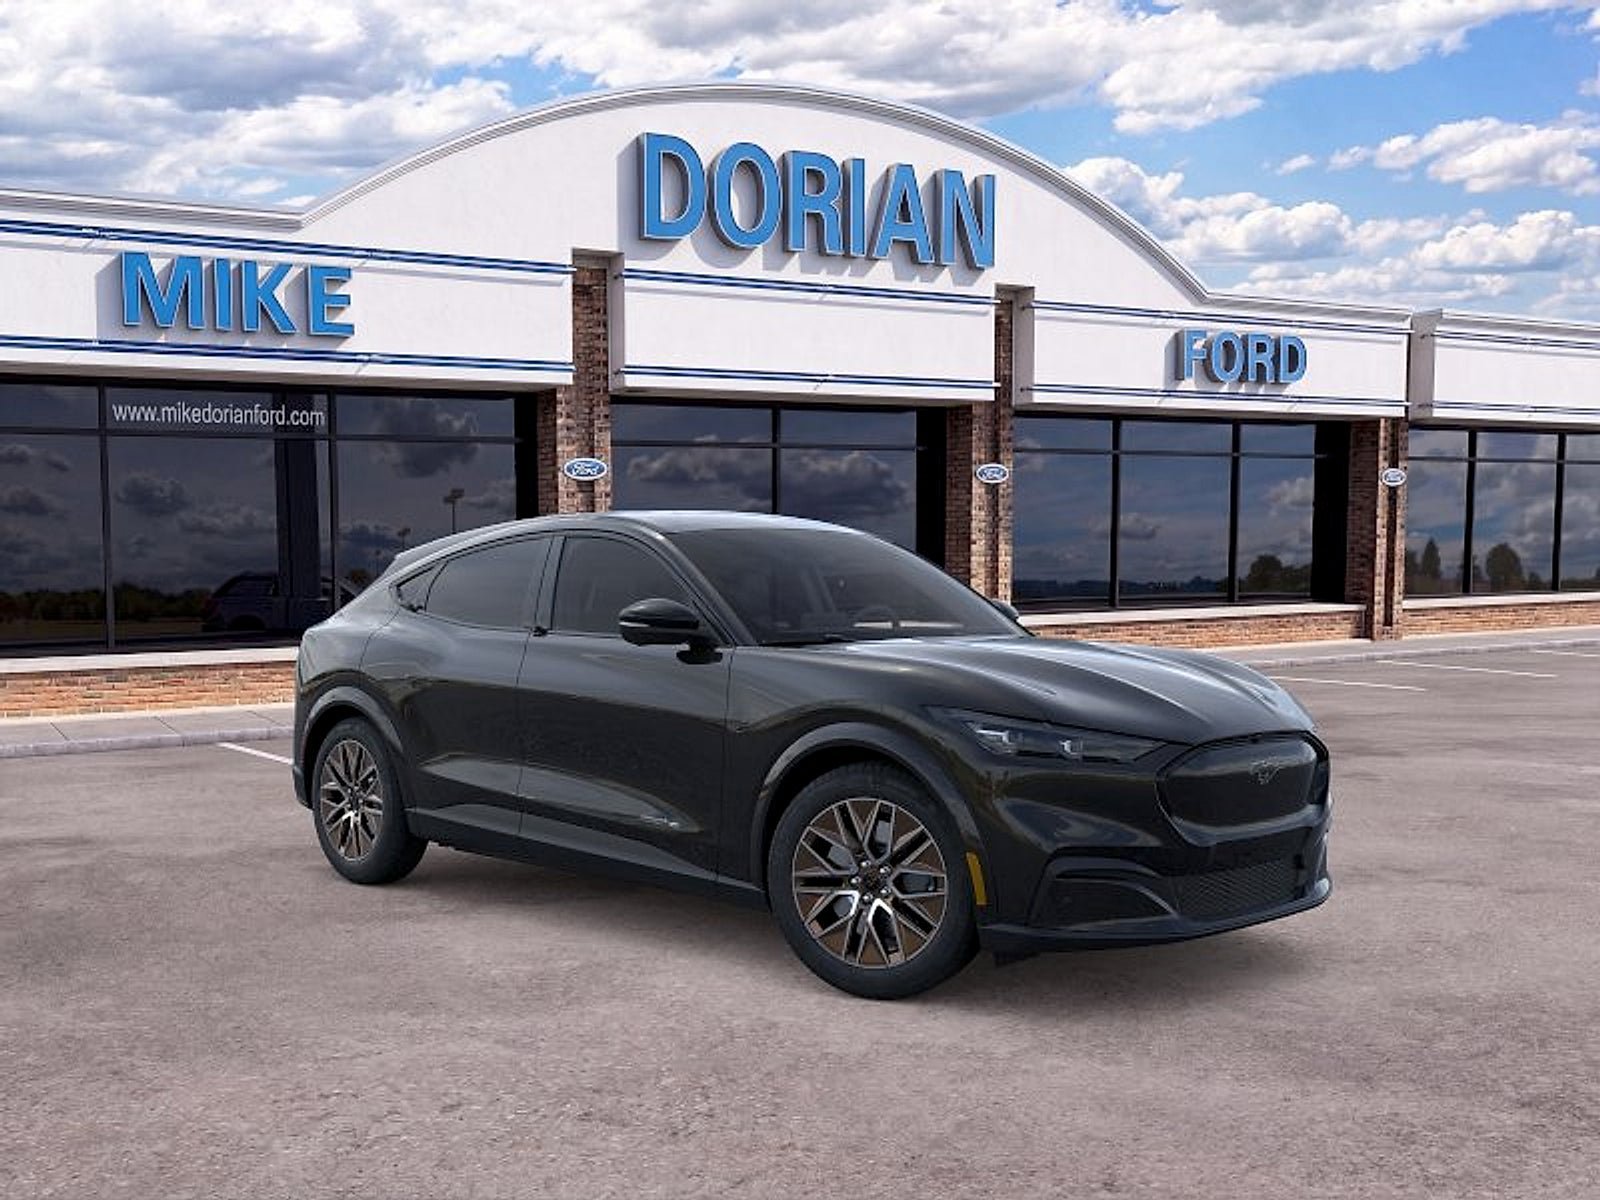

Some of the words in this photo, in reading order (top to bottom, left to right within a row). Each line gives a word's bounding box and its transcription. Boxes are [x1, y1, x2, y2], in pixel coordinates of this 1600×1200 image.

[640, 132, 995, 268] DORIAN
[121, 252, 355, 337] MIKE
[1180, 328, 1307, 384] FORD
[111, 402, 326, 426] www.mikedorianford.com
